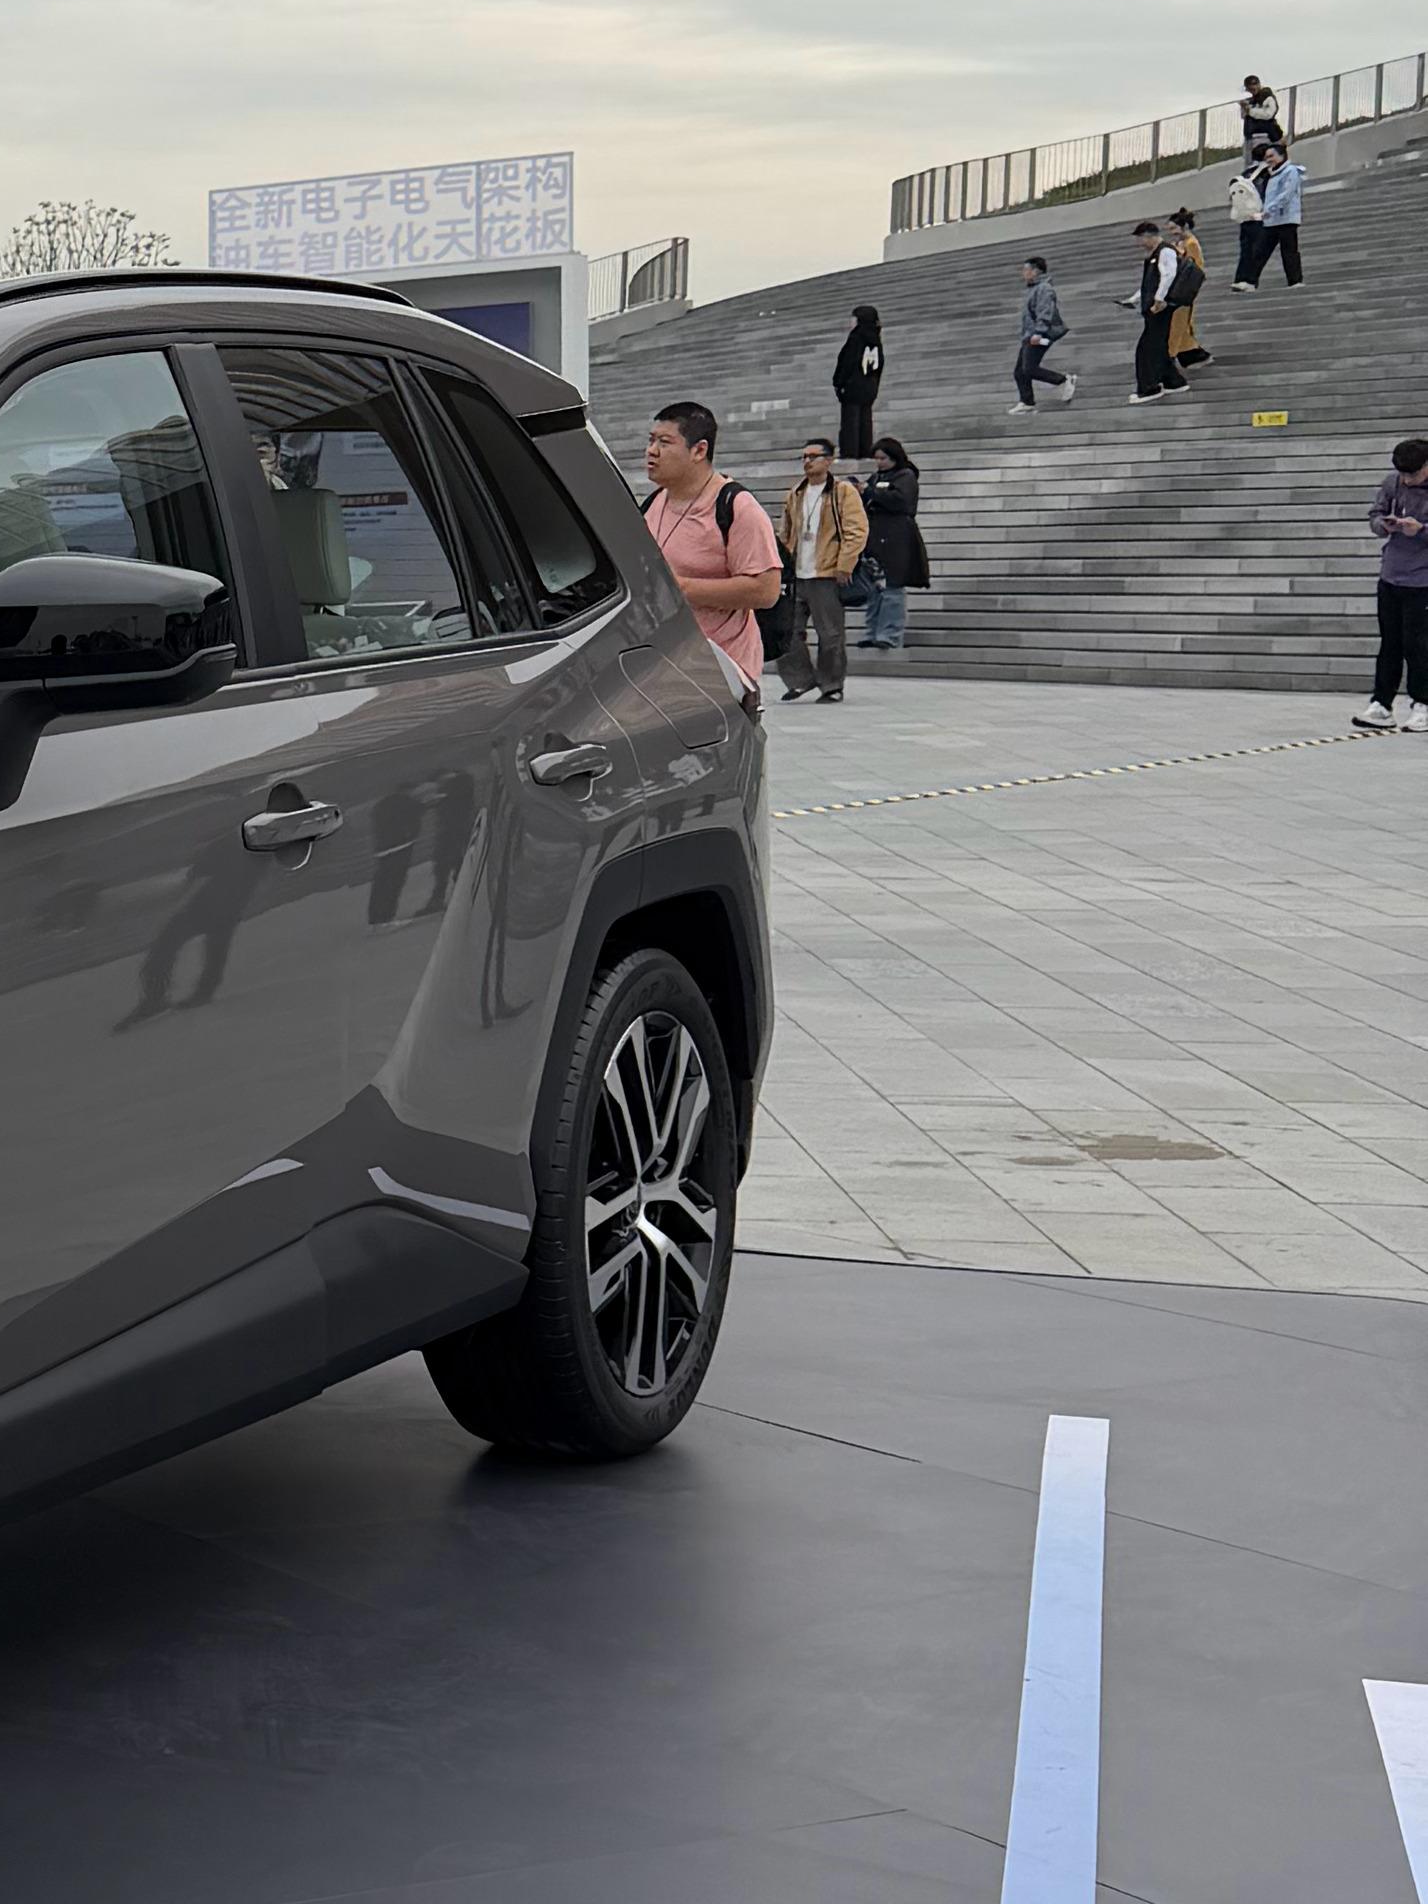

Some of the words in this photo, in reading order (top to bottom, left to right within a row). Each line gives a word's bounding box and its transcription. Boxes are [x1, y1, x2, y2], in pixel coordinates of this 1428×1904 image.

[215, 158, 568, 234] 全新电子电气架构
